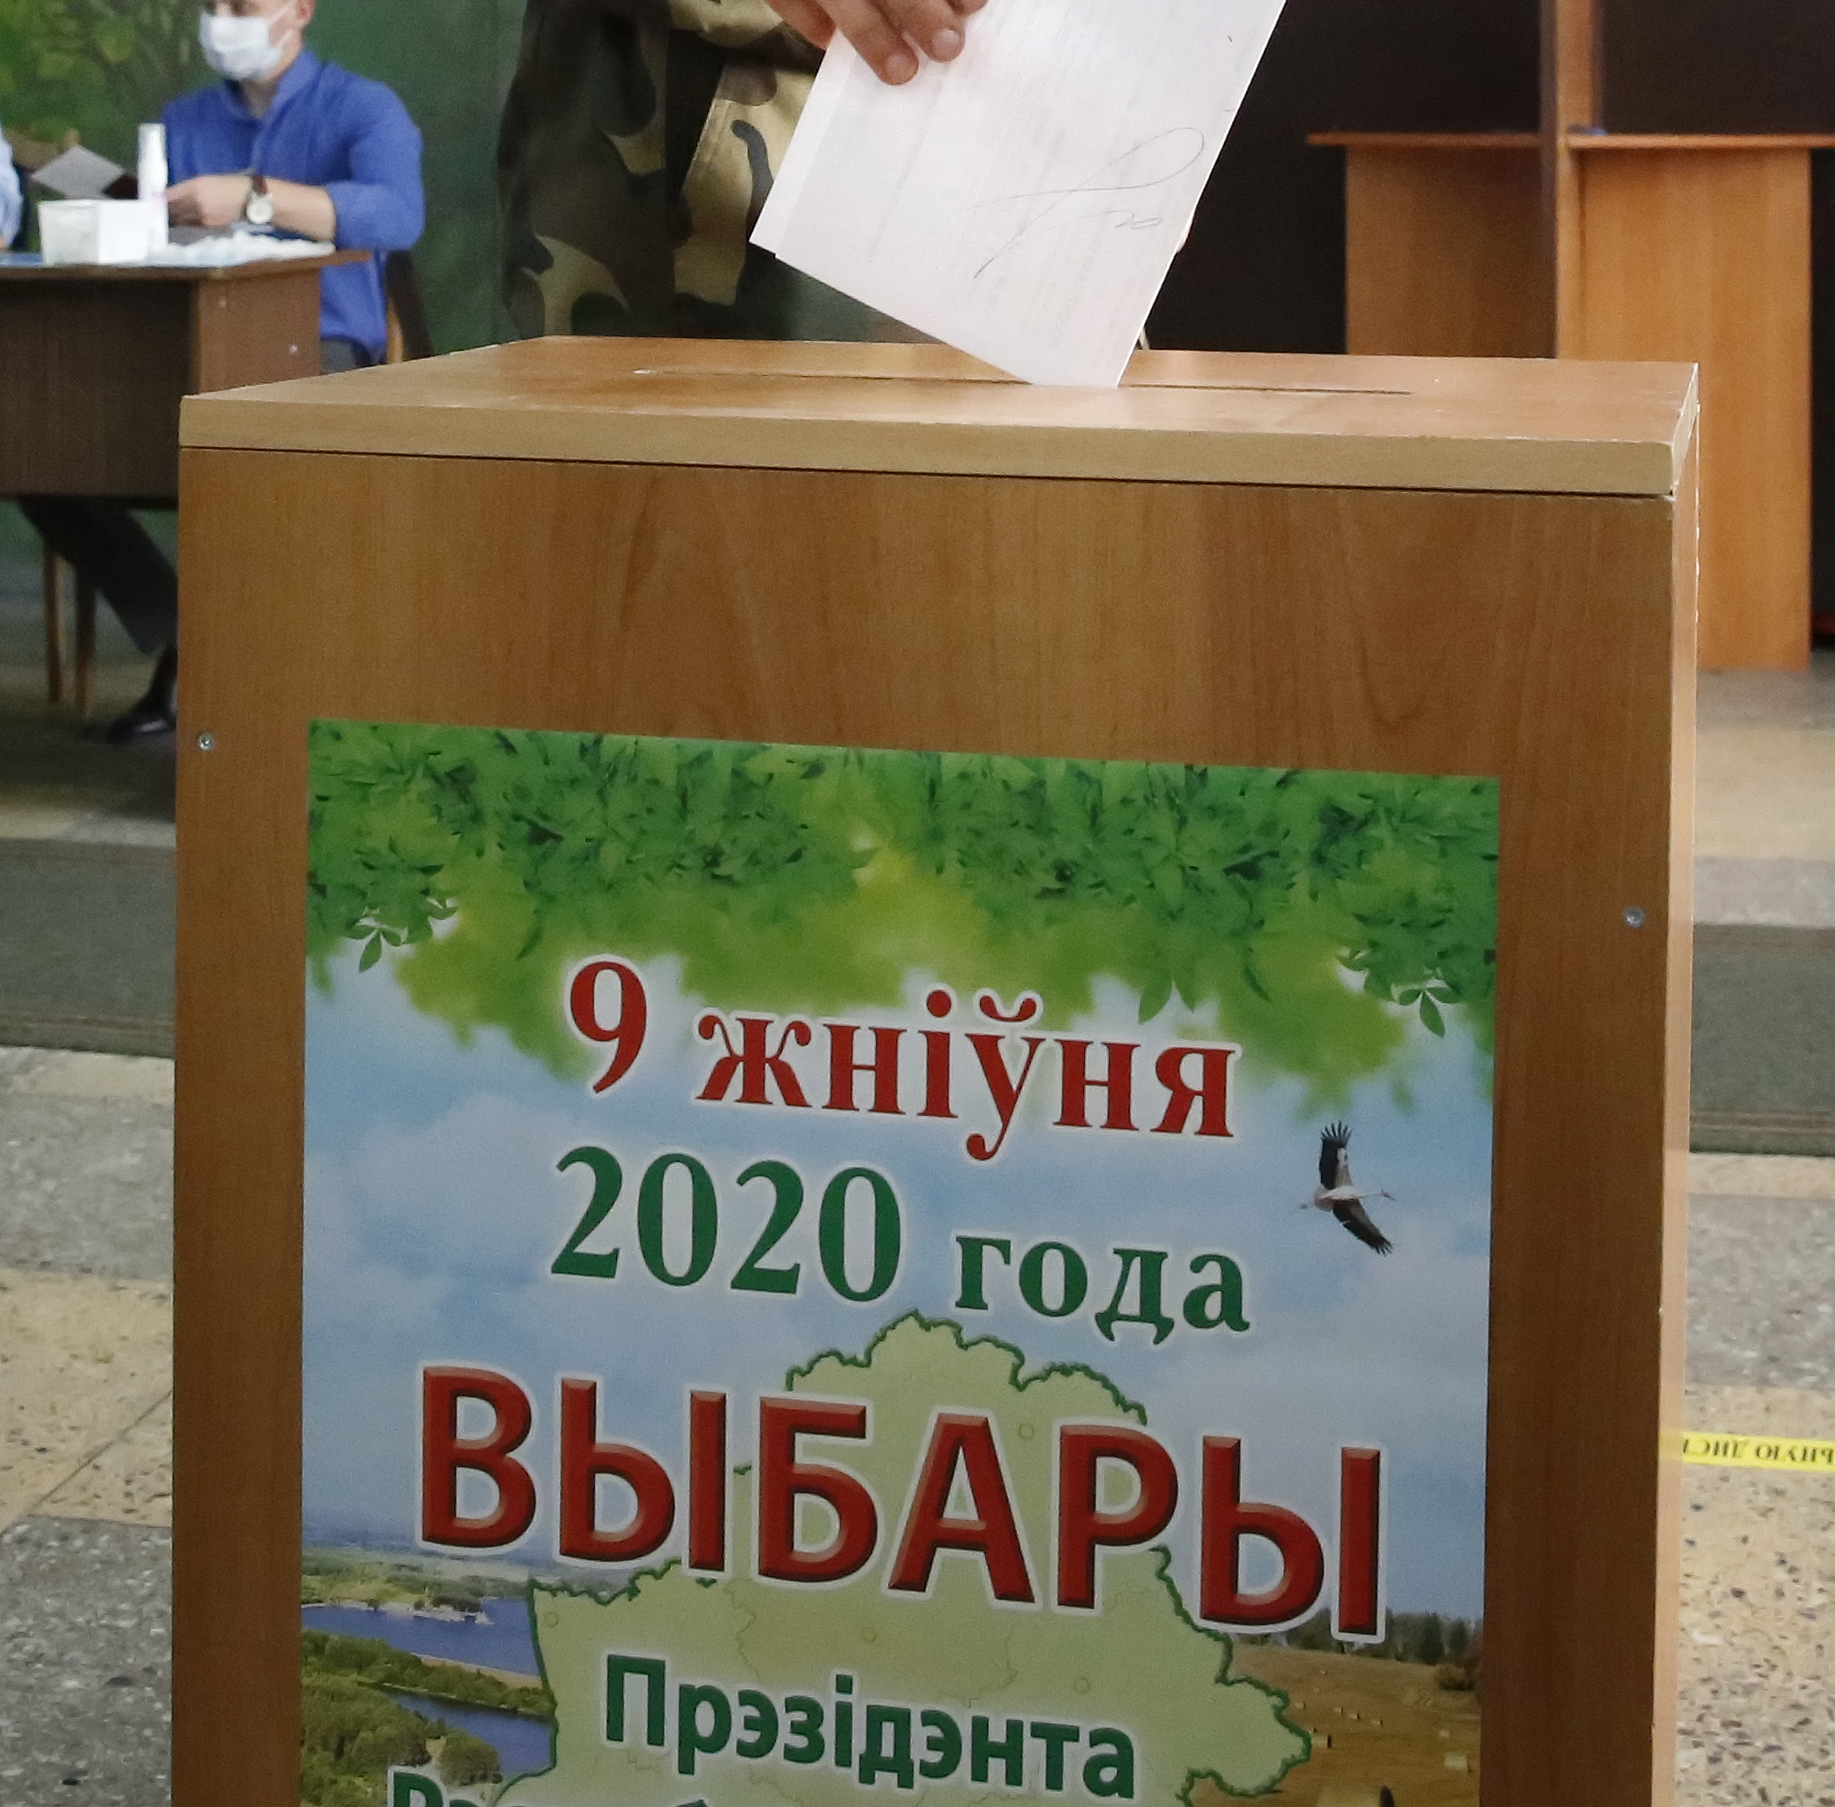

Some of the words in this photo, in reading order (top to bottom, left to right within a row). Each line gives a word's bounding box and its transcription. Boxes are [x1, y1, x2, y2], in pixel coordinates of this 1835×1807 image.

[569, 960, 647, 1094] 9
[698, 989, 1235, 1160] жніўня
[551, 1146, 902, 1302] 2020
[956, 1236, 1250, 1344] года
[421, 1366, 1381, 1636] ВЫБАРЫ
[605, 1656, 1135, 1799] Прэзідэнта
